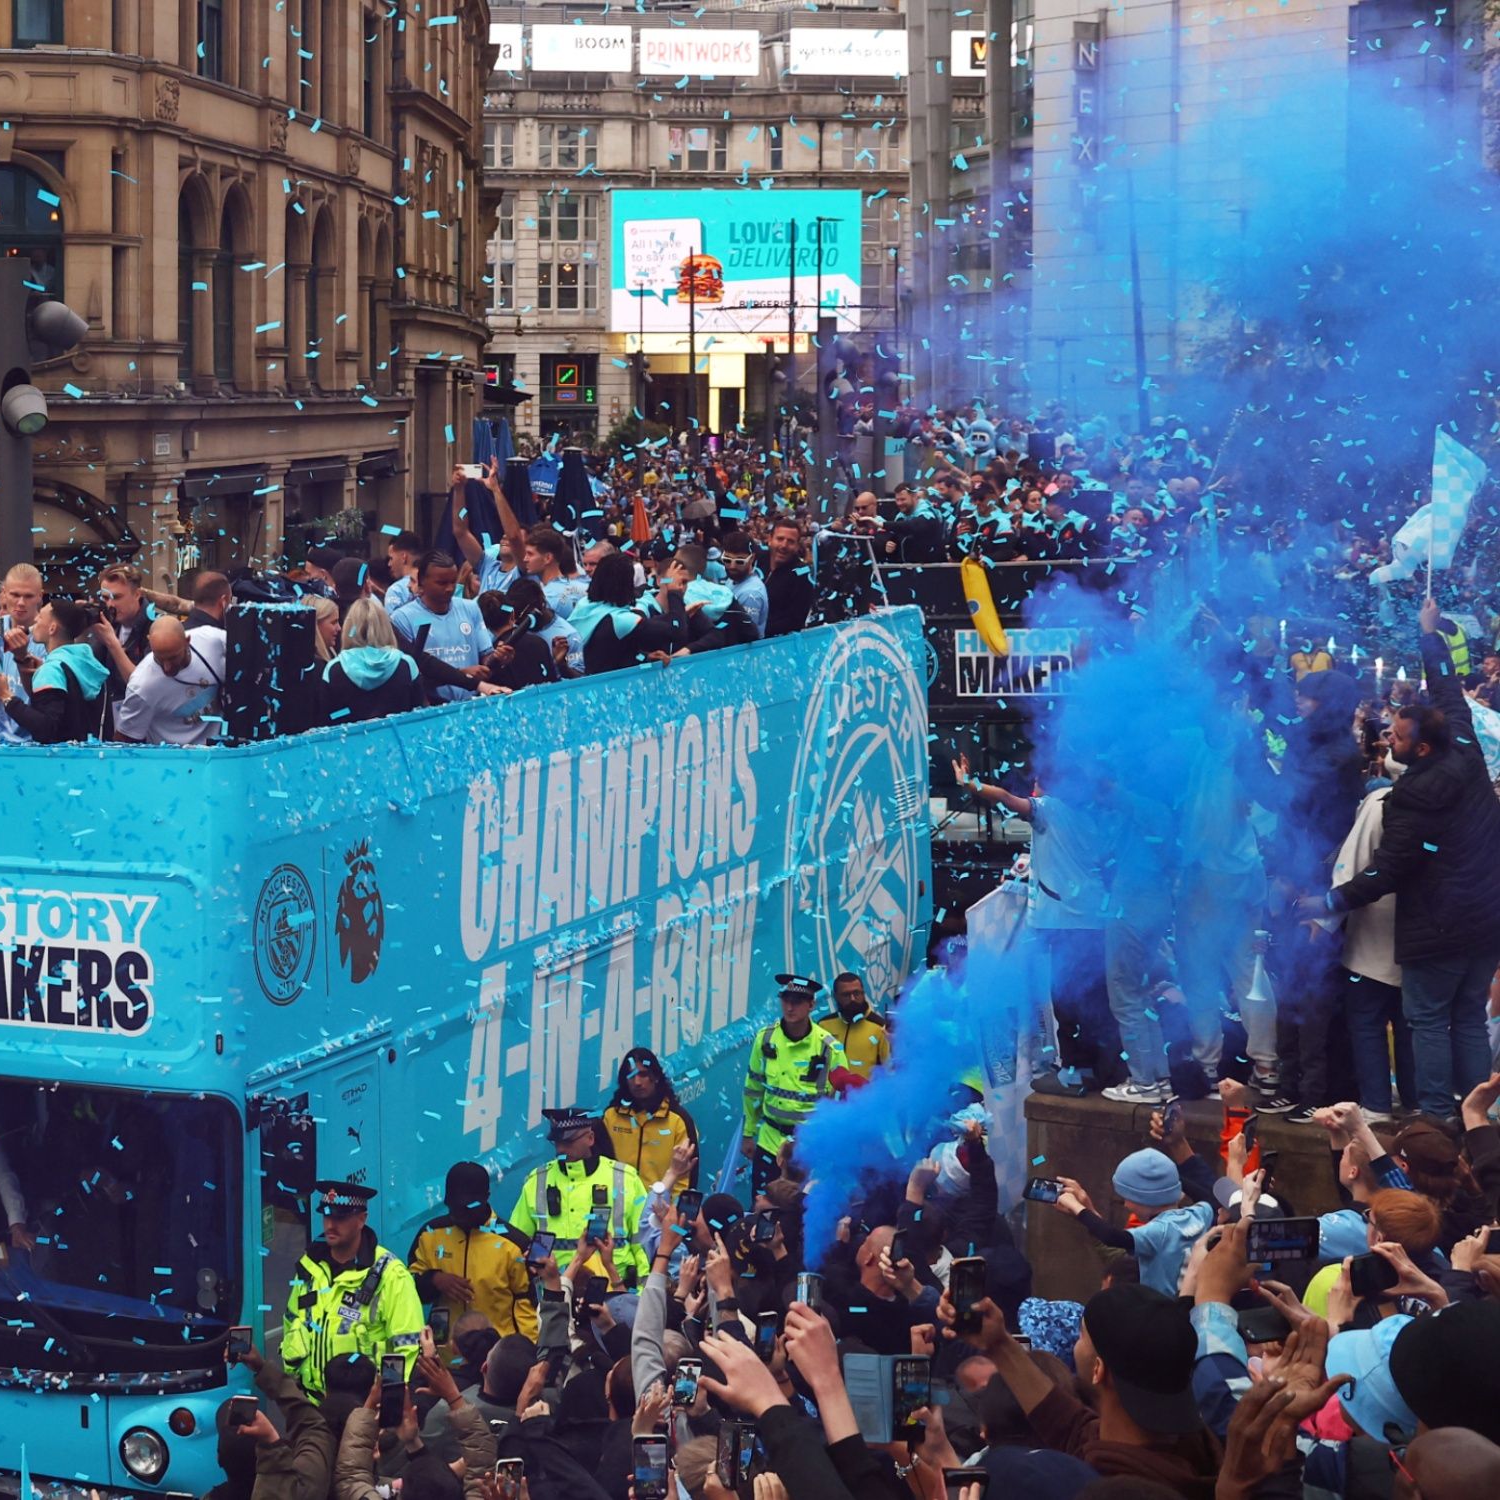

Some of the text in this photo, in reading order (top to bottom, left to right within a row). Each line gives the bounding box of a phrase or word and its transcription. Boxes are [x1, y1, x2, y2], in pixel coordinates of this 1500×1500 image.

[575, 37, 626, 49] BOOM
[647, 41, 752, 63] PRINTWORKS
[799, 46, 901, 58] wethespoon
[729, 221, 838, 244] LOVED ON
[729, 247, 839, 267] DELIVEROO
[427, 644, 471, 656] ETIHAD
[958, 630, 1092, 653] HITORY
[959, 655, 1072, 694] MAKER
[460, 700, 760, 962] CHAMPIONS
[260, 874, 309, 924] MANCHESTER
[277, 980, 295, 996] CITY
[463, 860, 760, 1153] 4-IN-A-ROW
